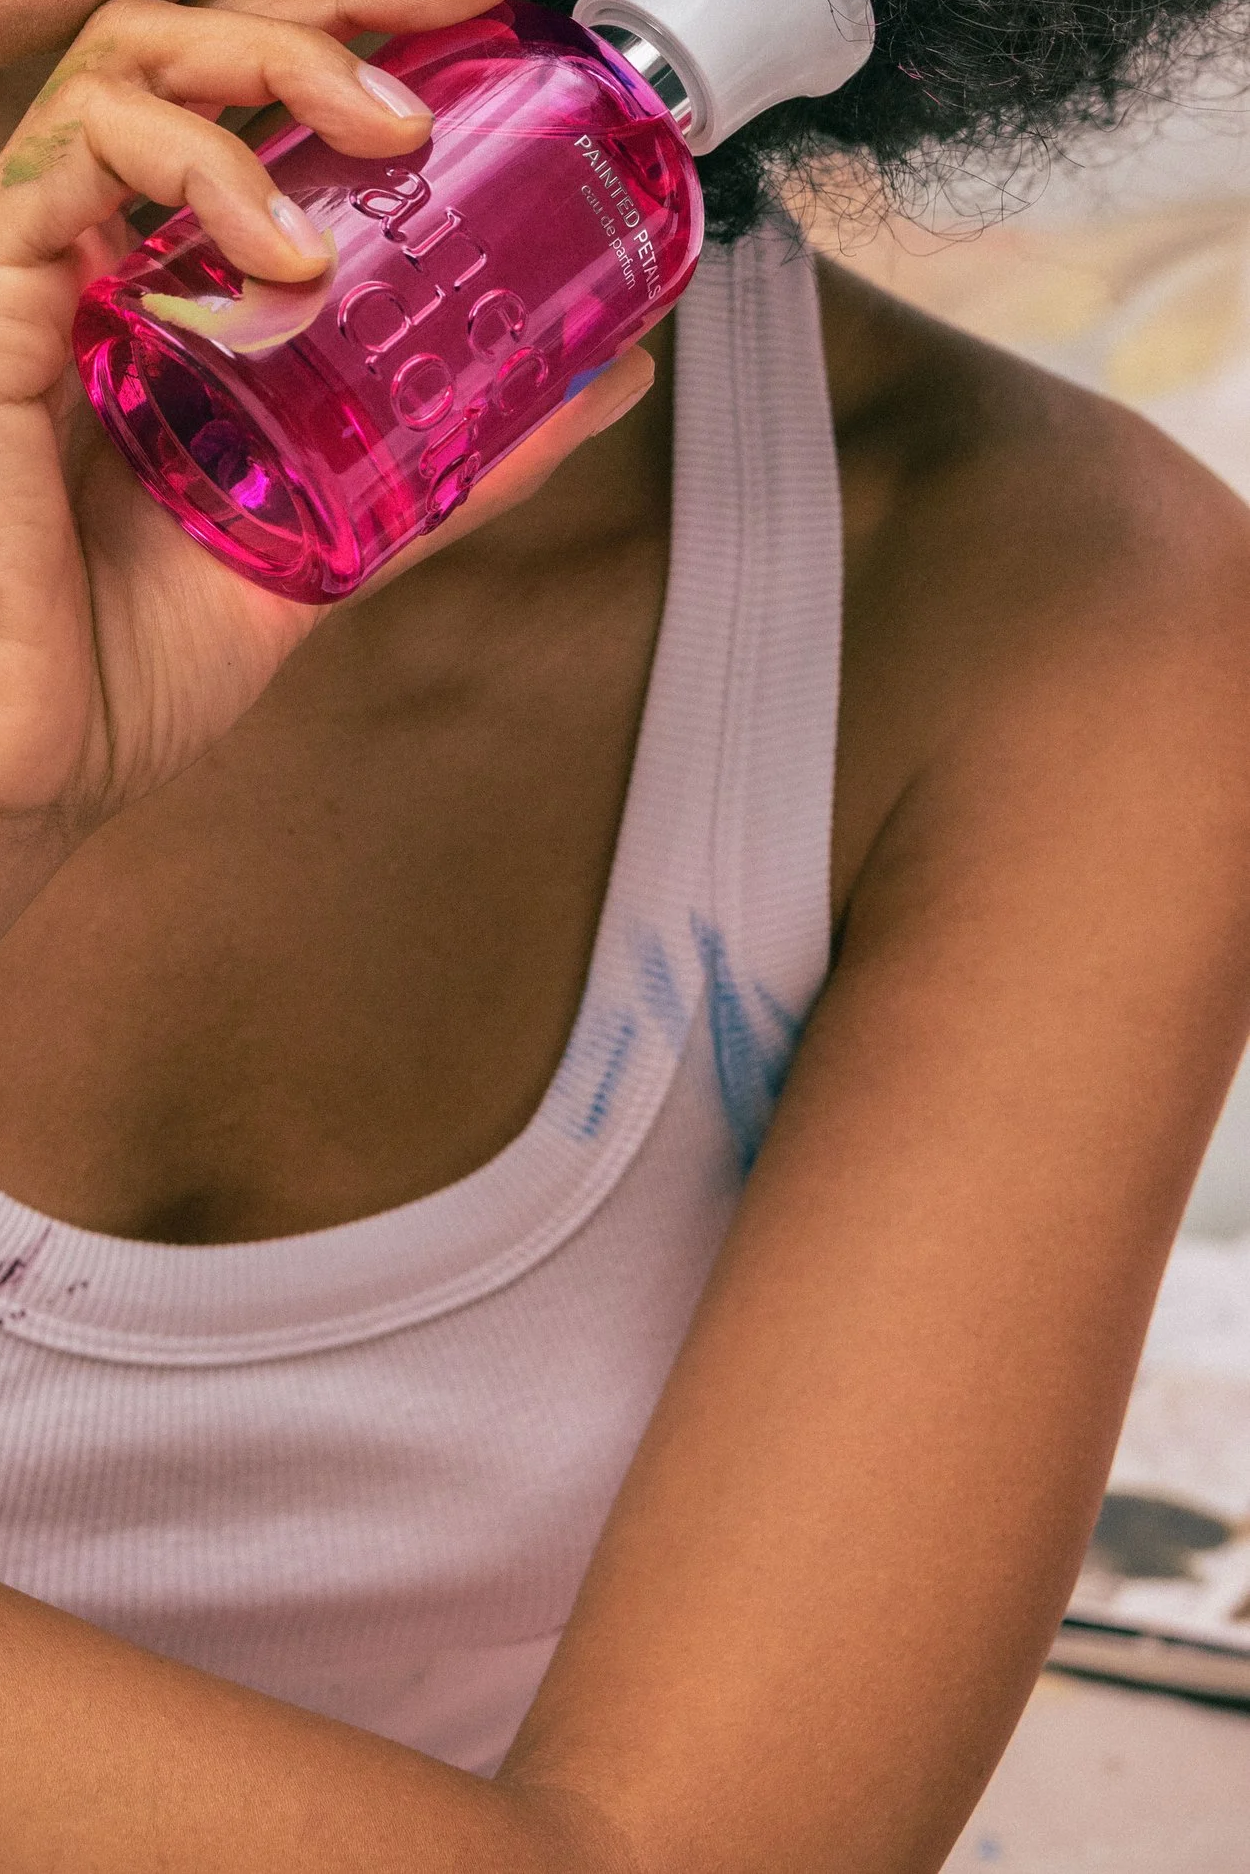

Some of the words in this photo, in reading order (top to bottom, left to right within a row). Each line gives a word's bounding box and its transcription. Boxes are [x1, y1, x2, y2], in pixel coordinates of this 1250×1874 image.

[350, 164, 549, 417] anec
[574, 134, 640, 228] PAINTED
[634, 229, 663, 300] PETALS
[581, 184, 605, 215] eau
[600, 213, 617, 237] de
[609, 236, 637, 290] parfum
